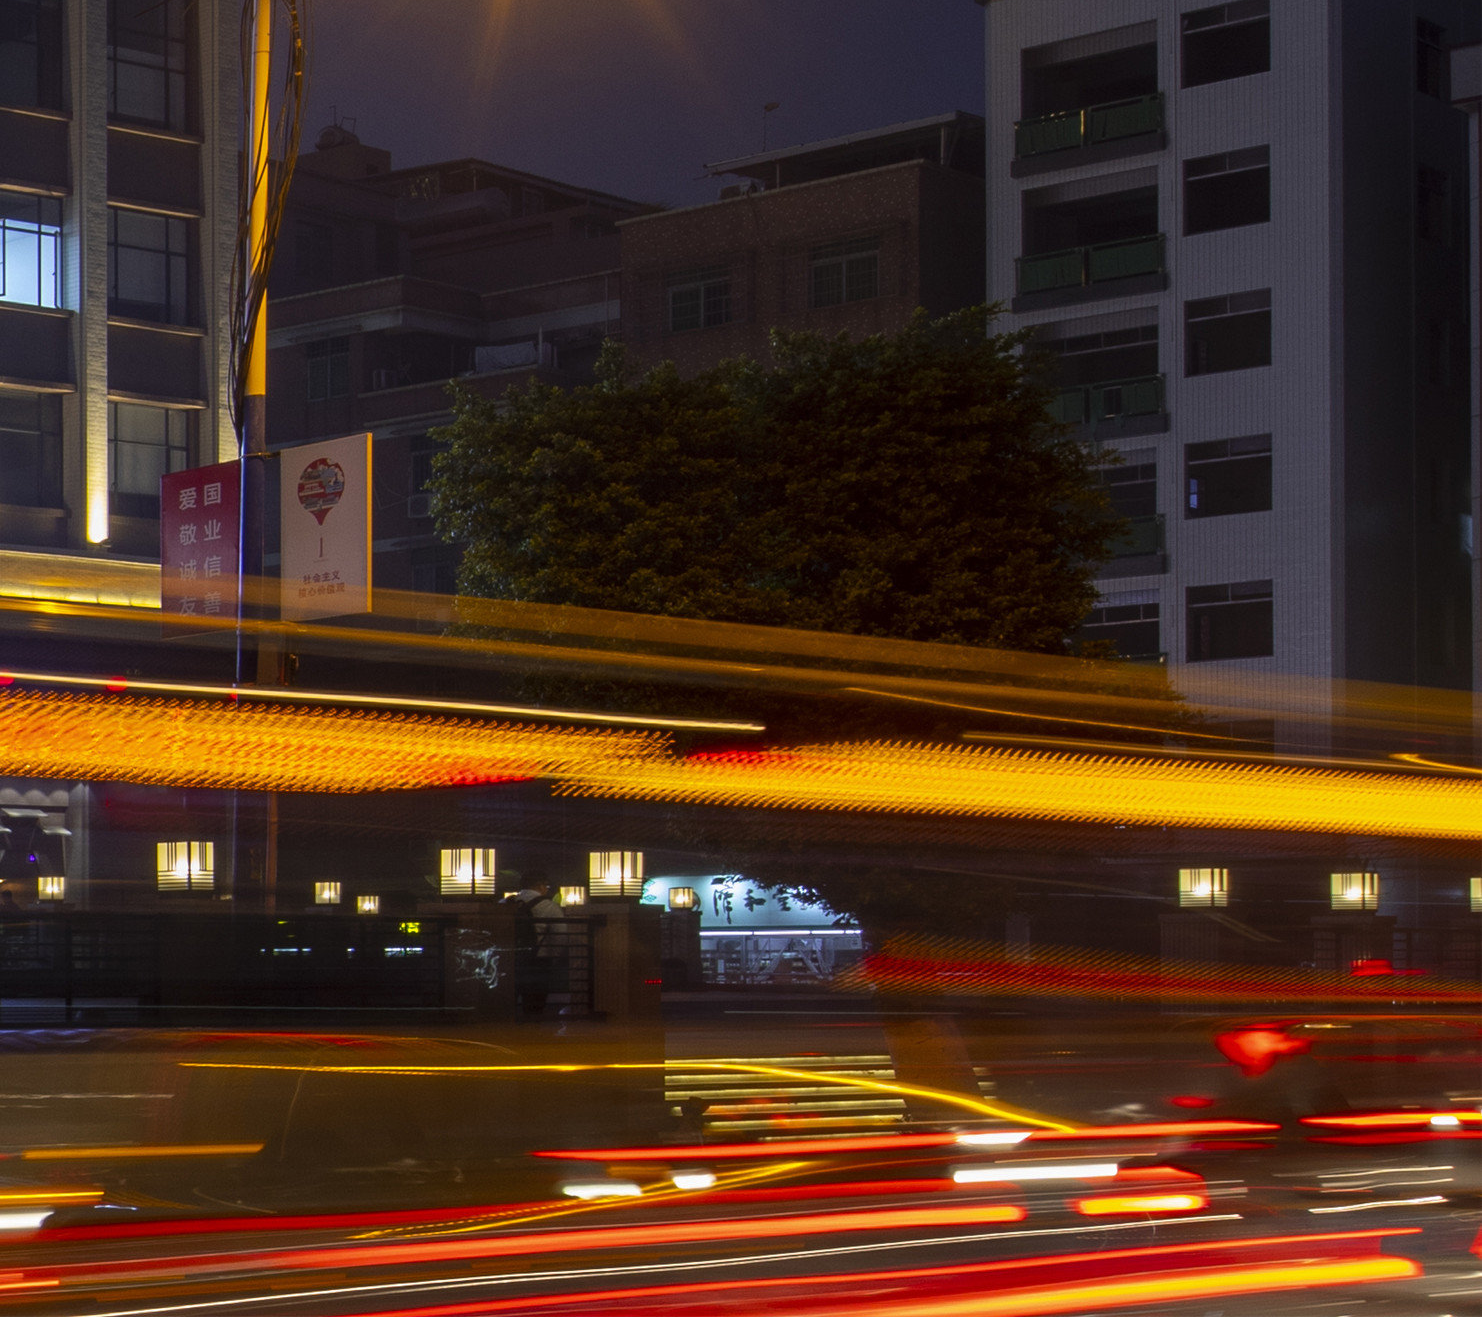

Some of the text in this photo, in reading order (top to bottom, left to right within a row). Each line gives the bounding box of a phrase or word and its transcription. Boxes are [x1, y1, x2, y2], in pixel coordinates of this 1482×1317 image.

[179, 482, 222, 511] 爱国
[179, 519, 222, 546] 敬业
[179, 556, 222, 581] 诚信
[179, 591, 222, 616] 友善
